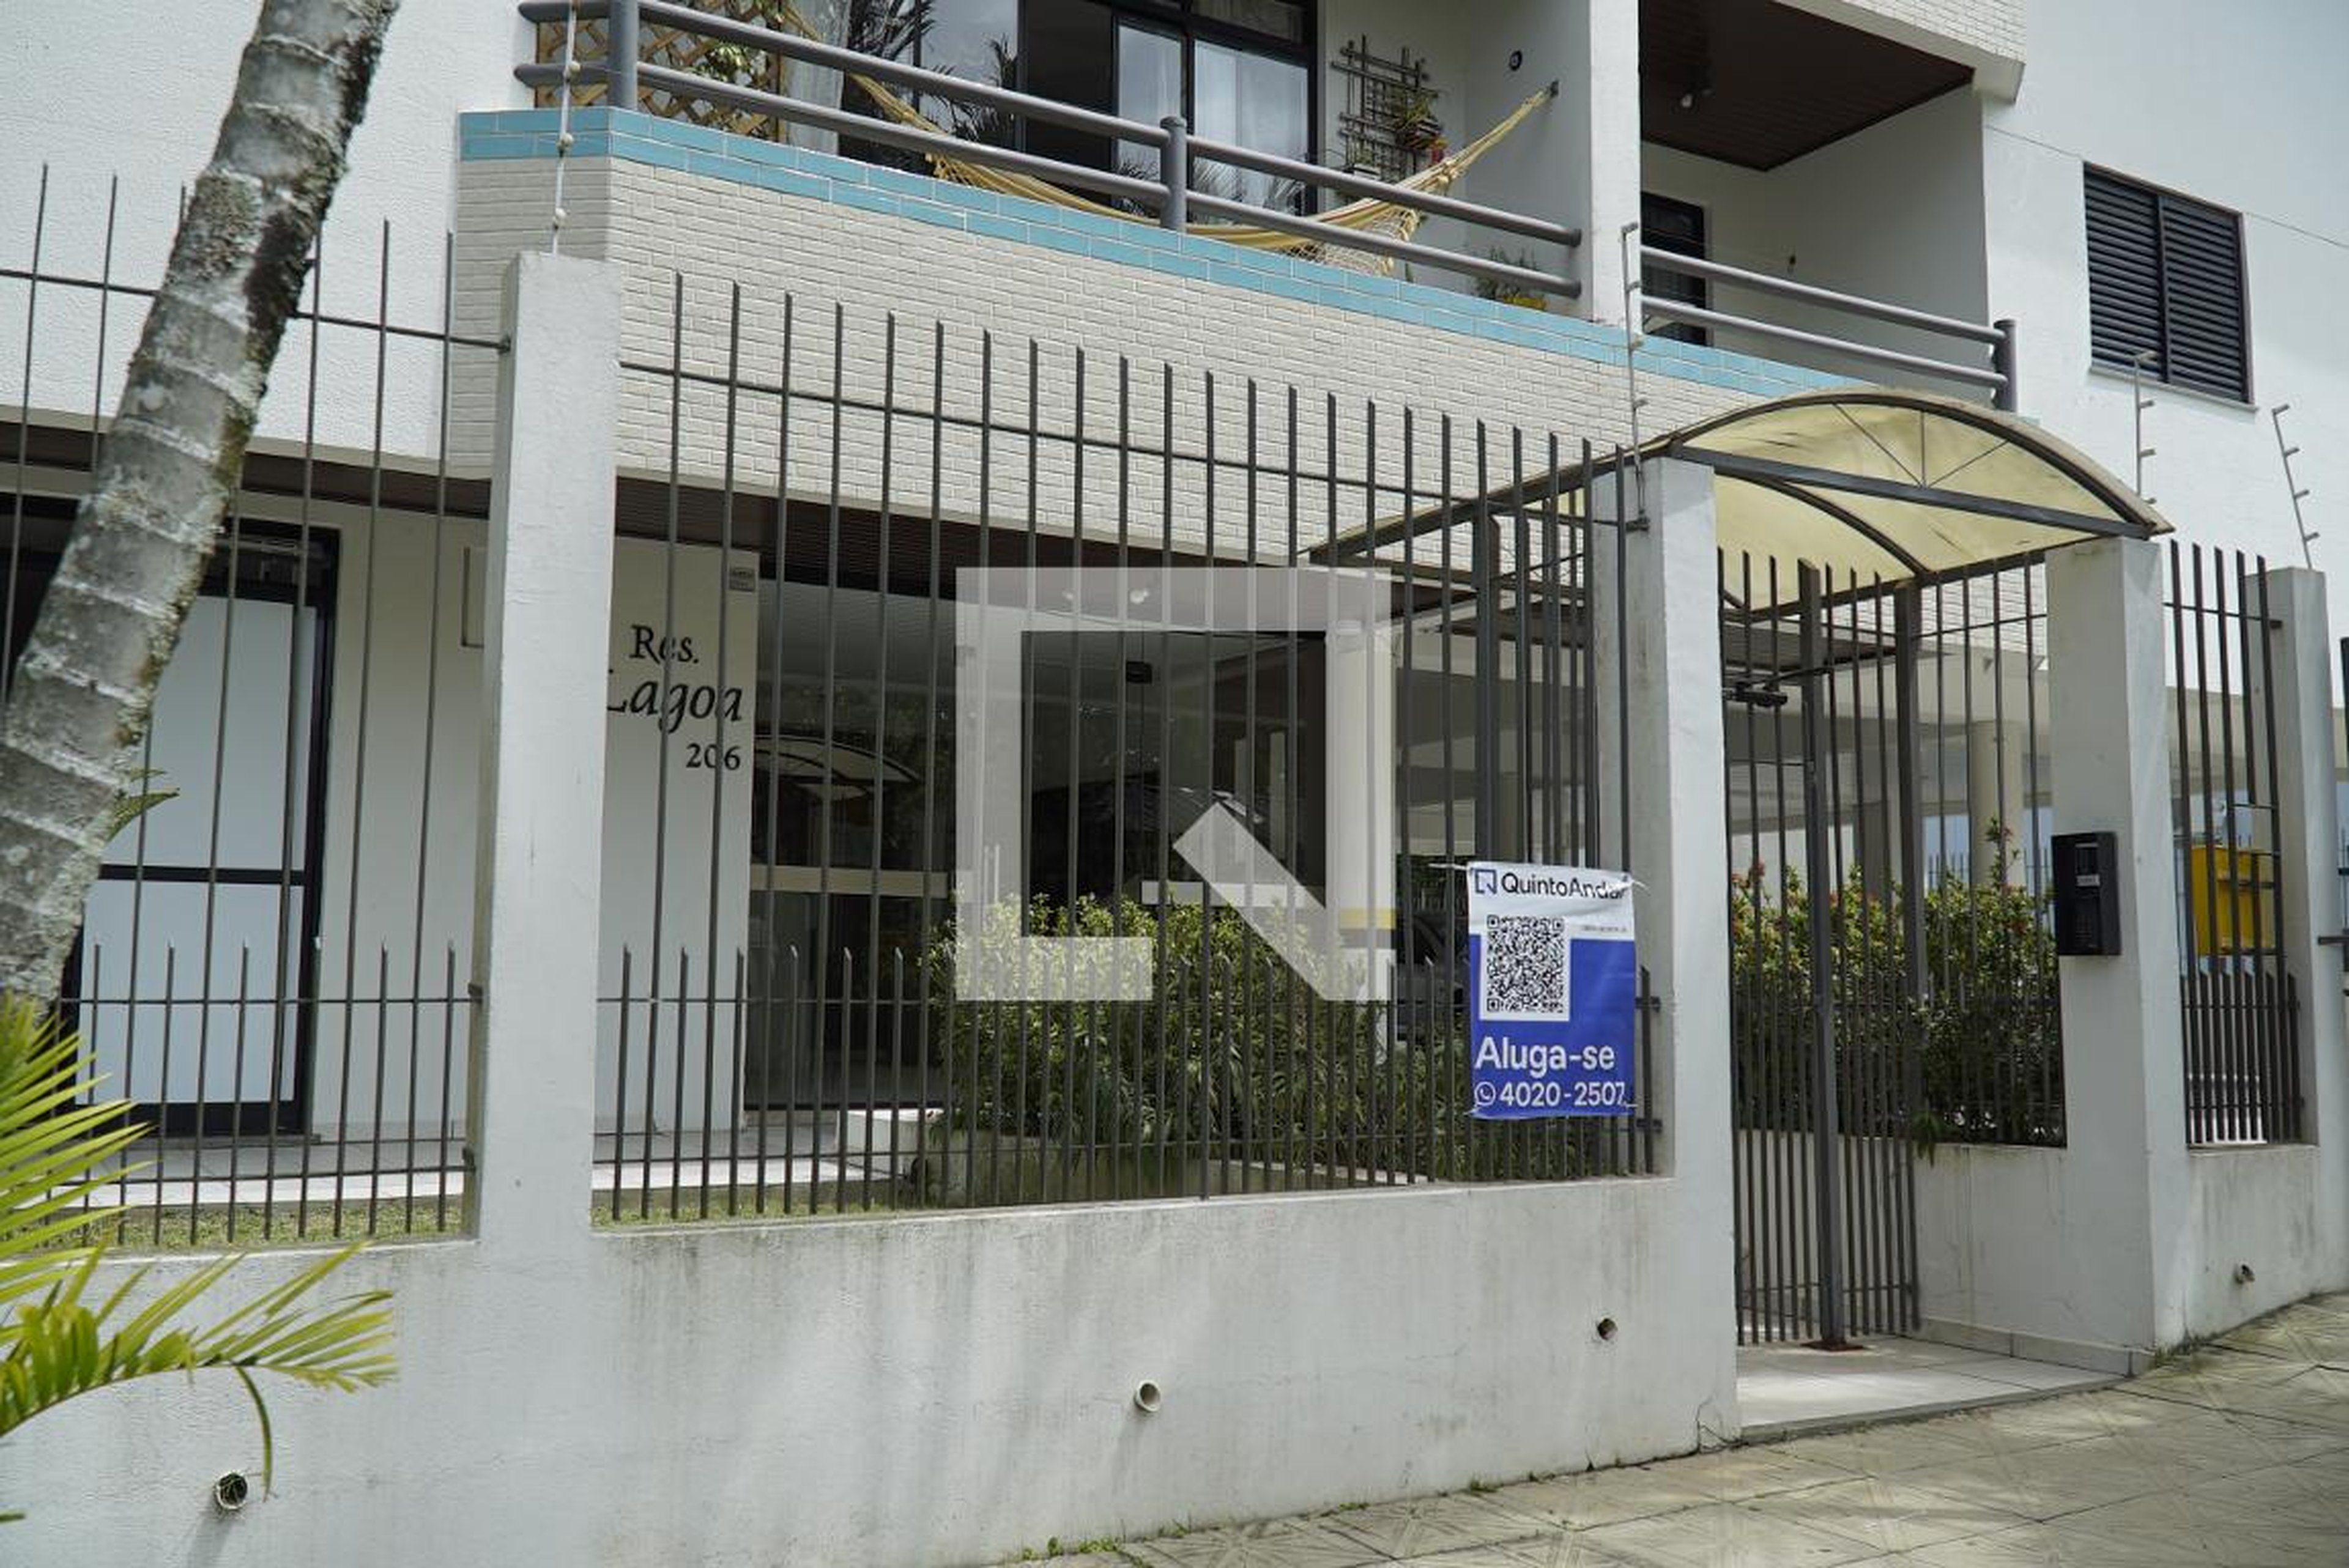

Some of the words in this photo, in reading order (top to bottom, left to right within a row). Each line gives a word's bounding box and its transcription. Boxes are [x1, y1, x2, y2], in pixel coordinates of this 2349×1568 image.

[629, 624, 699, 665] Res.
[686, 742, 741, 771] 206
[1474, 1036, 1616, 1079] Aluga-se
